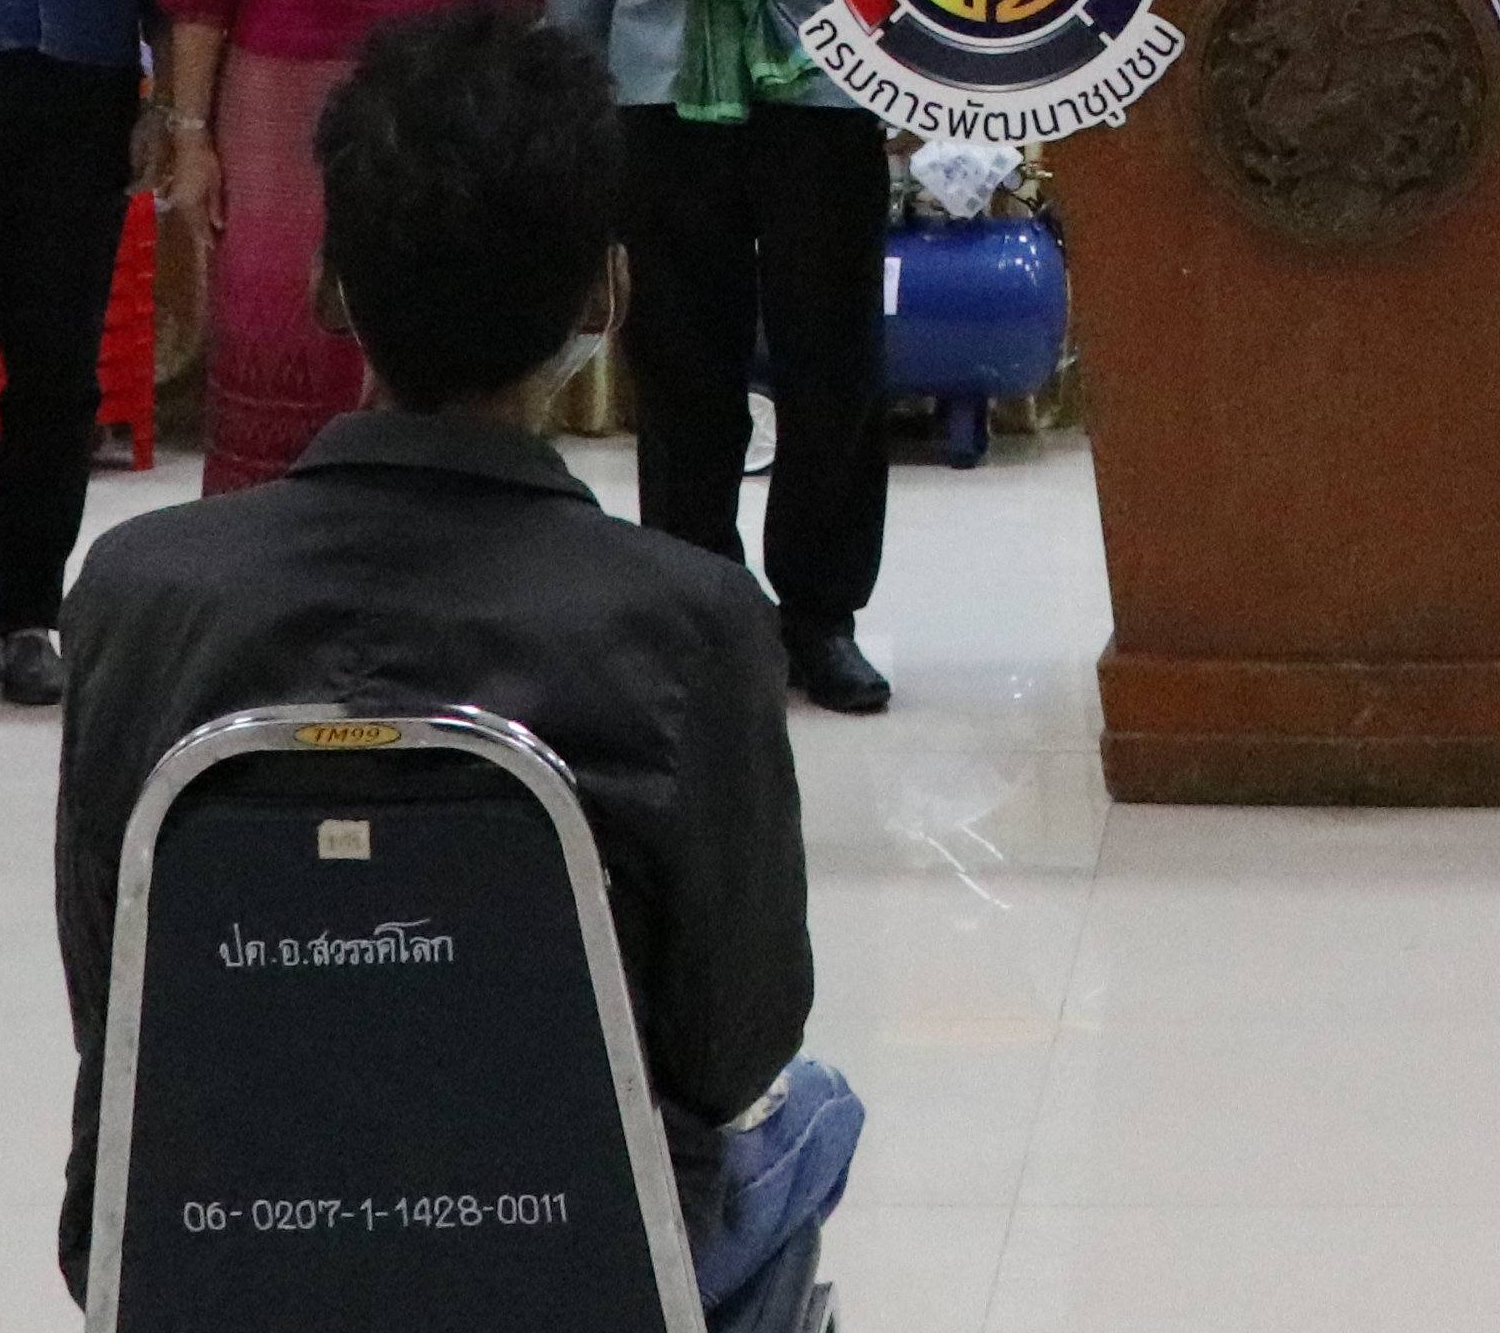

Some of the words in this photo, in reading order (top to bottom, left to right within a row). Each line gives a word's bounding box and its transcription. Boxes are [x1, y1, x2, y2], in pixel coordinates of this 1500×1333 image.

[804, 17, 1181, 142] กรมการพัฒนาชุมชน
[313, 727, 381, 744] TM99
[183, 1193, 569, 1232] 06-0207-1-1428-0011
